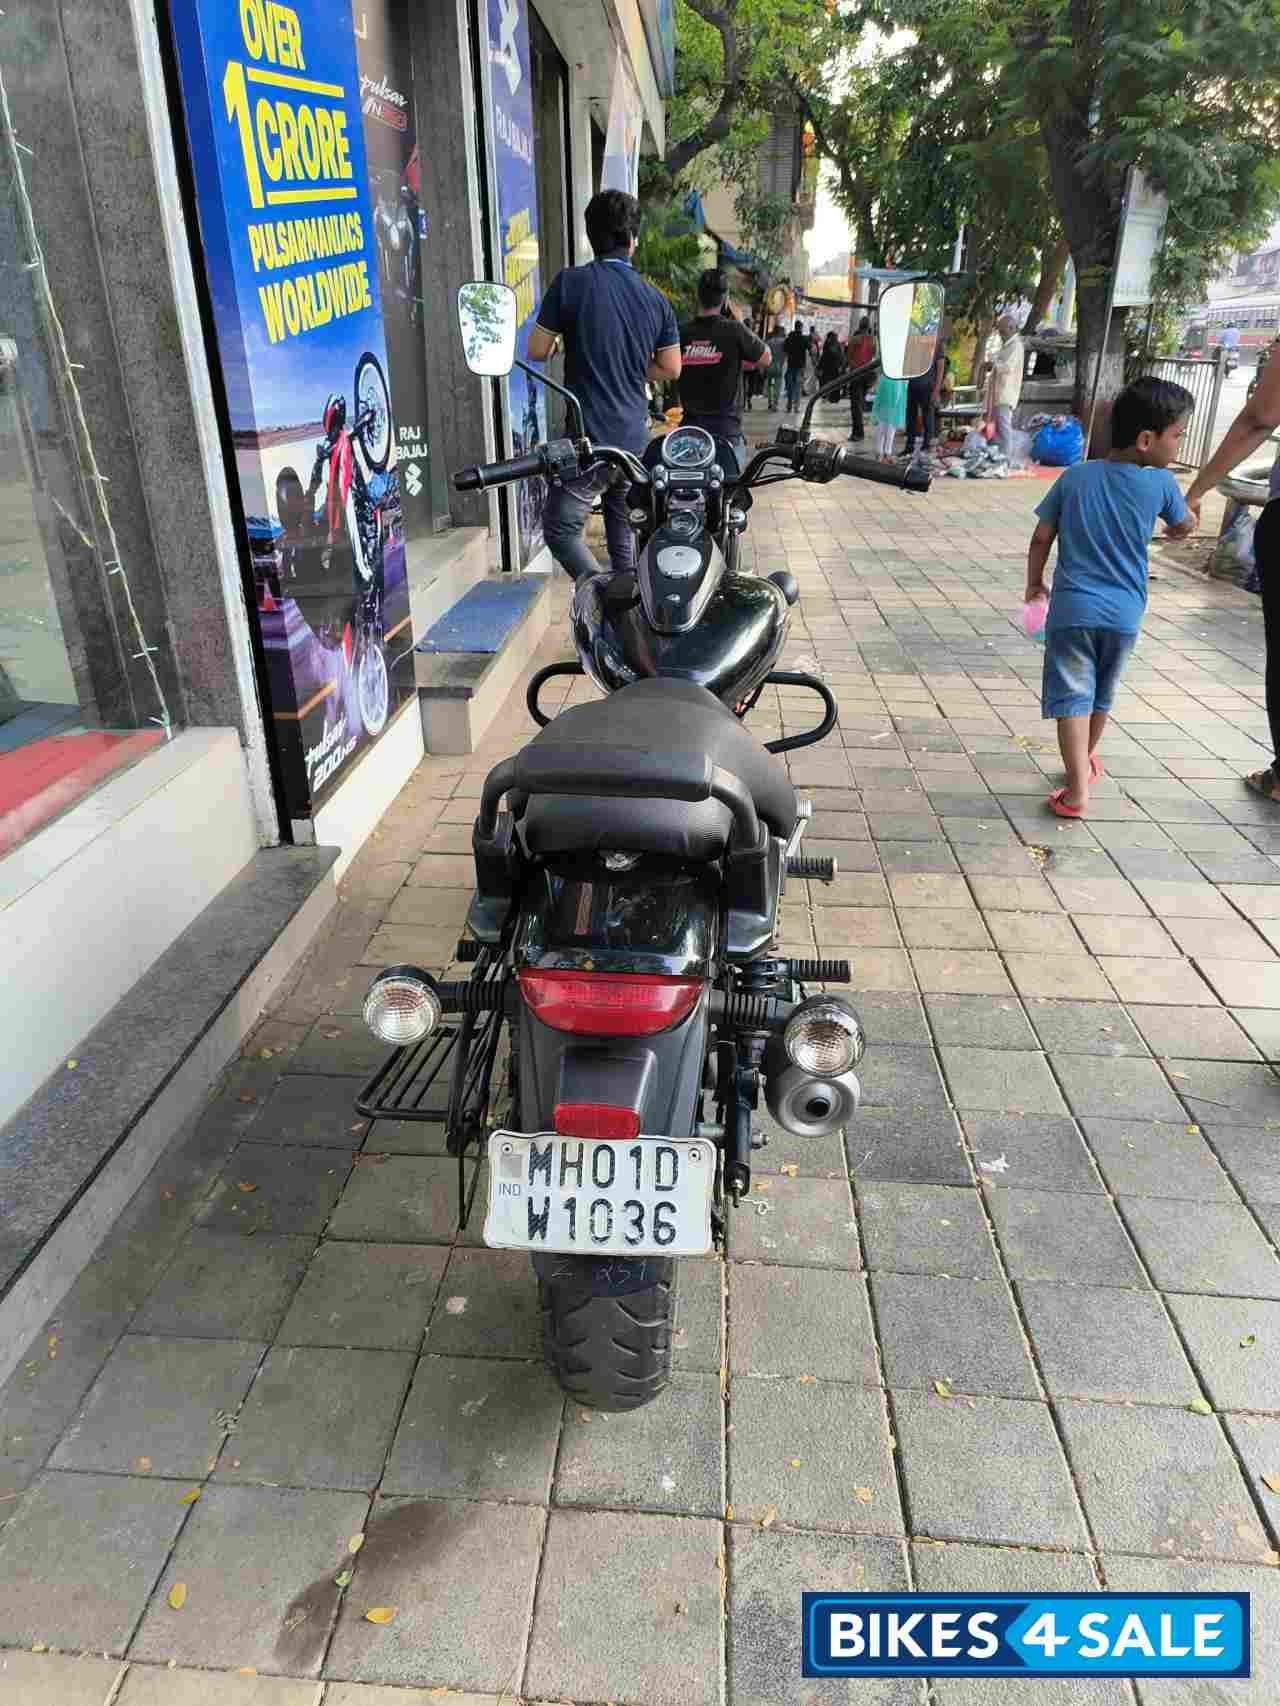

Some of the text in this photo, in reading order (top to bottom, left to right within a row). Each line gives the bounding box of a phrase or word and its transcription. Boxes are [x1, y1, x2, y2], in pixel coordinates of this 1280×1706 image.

[240, 0, 305, 71] OVER
[223, 61, 353, 208] 1 CRORE
[248, 211, 364, 273] PULSARMANIACS
[258, 260, 372, 345] WORLDWIDE
[499, 1183, 521, 1197] IND
[528, 1141, 680, 1192] MH01D
[527, 1195, 678, 1247] W1036
